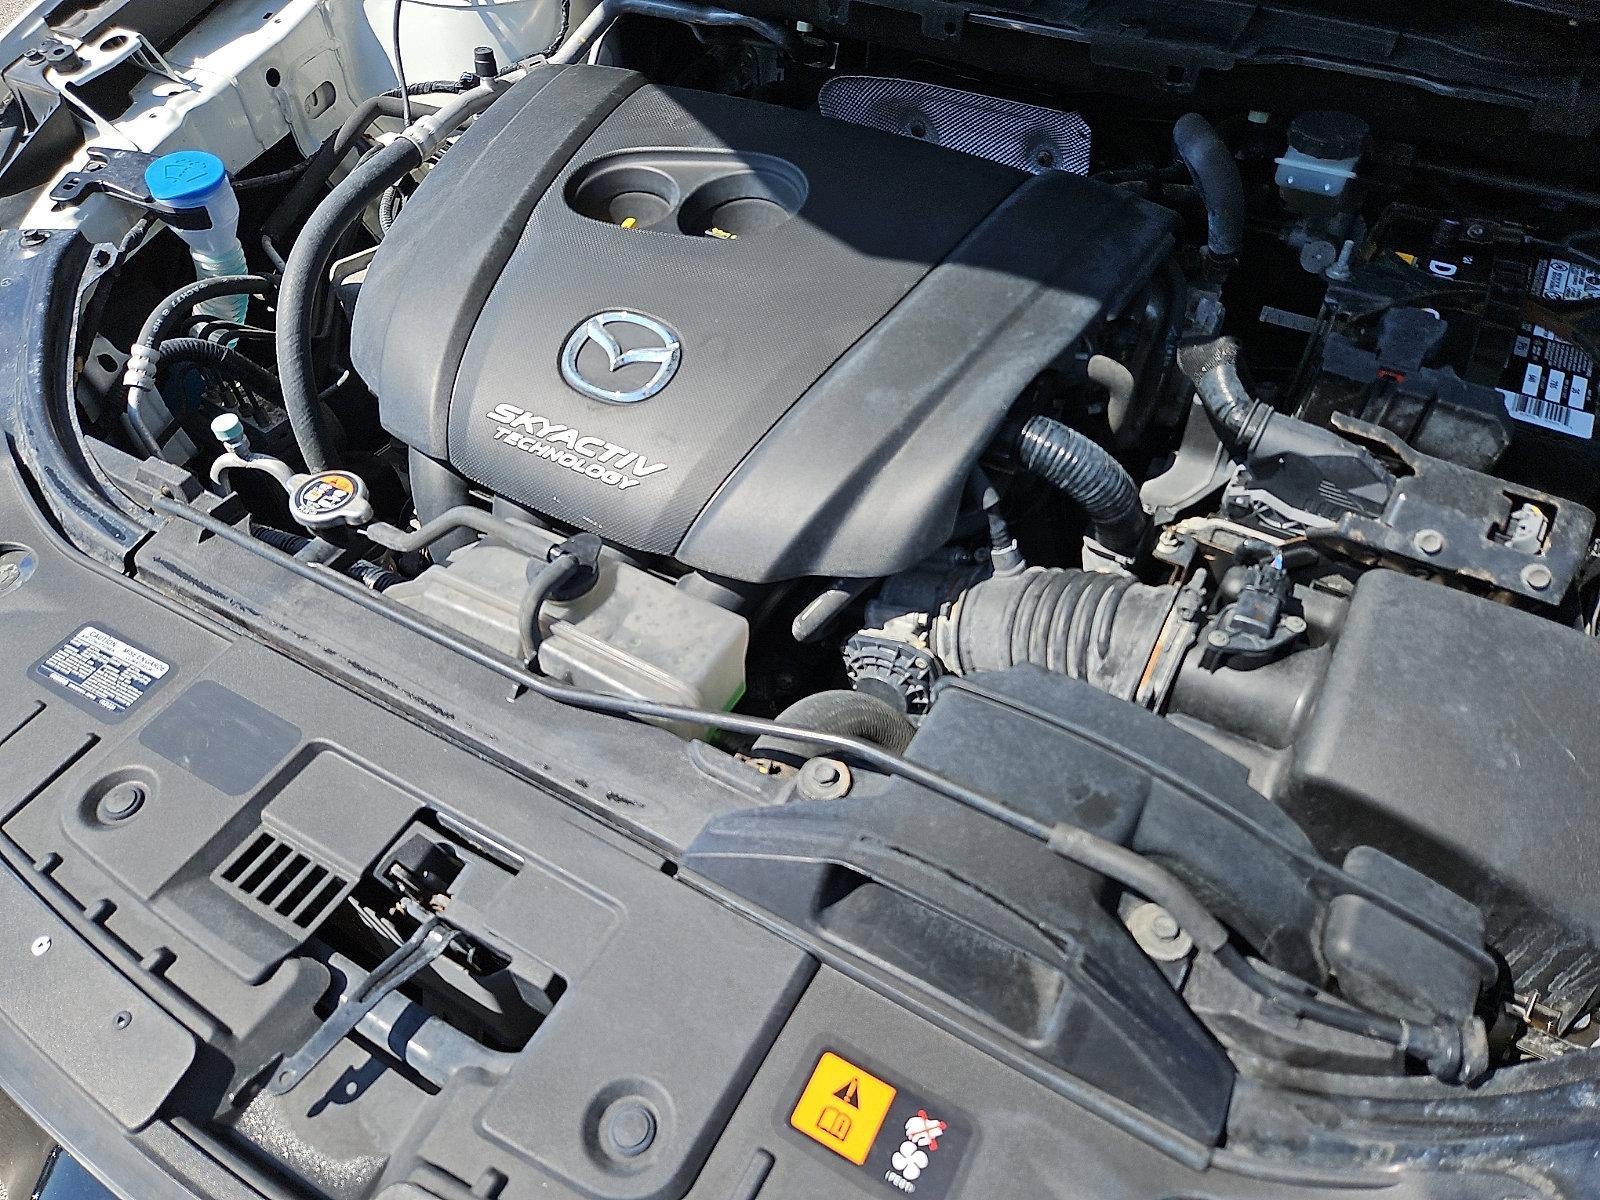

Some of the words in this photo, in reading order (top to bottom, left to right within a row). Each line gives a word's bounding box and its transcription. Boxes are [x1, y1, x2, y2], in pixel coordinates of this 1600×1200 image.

[486, 403, 668, 477] SKYACTIV
[493, 426, 640, 490] TECHNOLOGY
[89, 630, 118, 648] CAUTION
